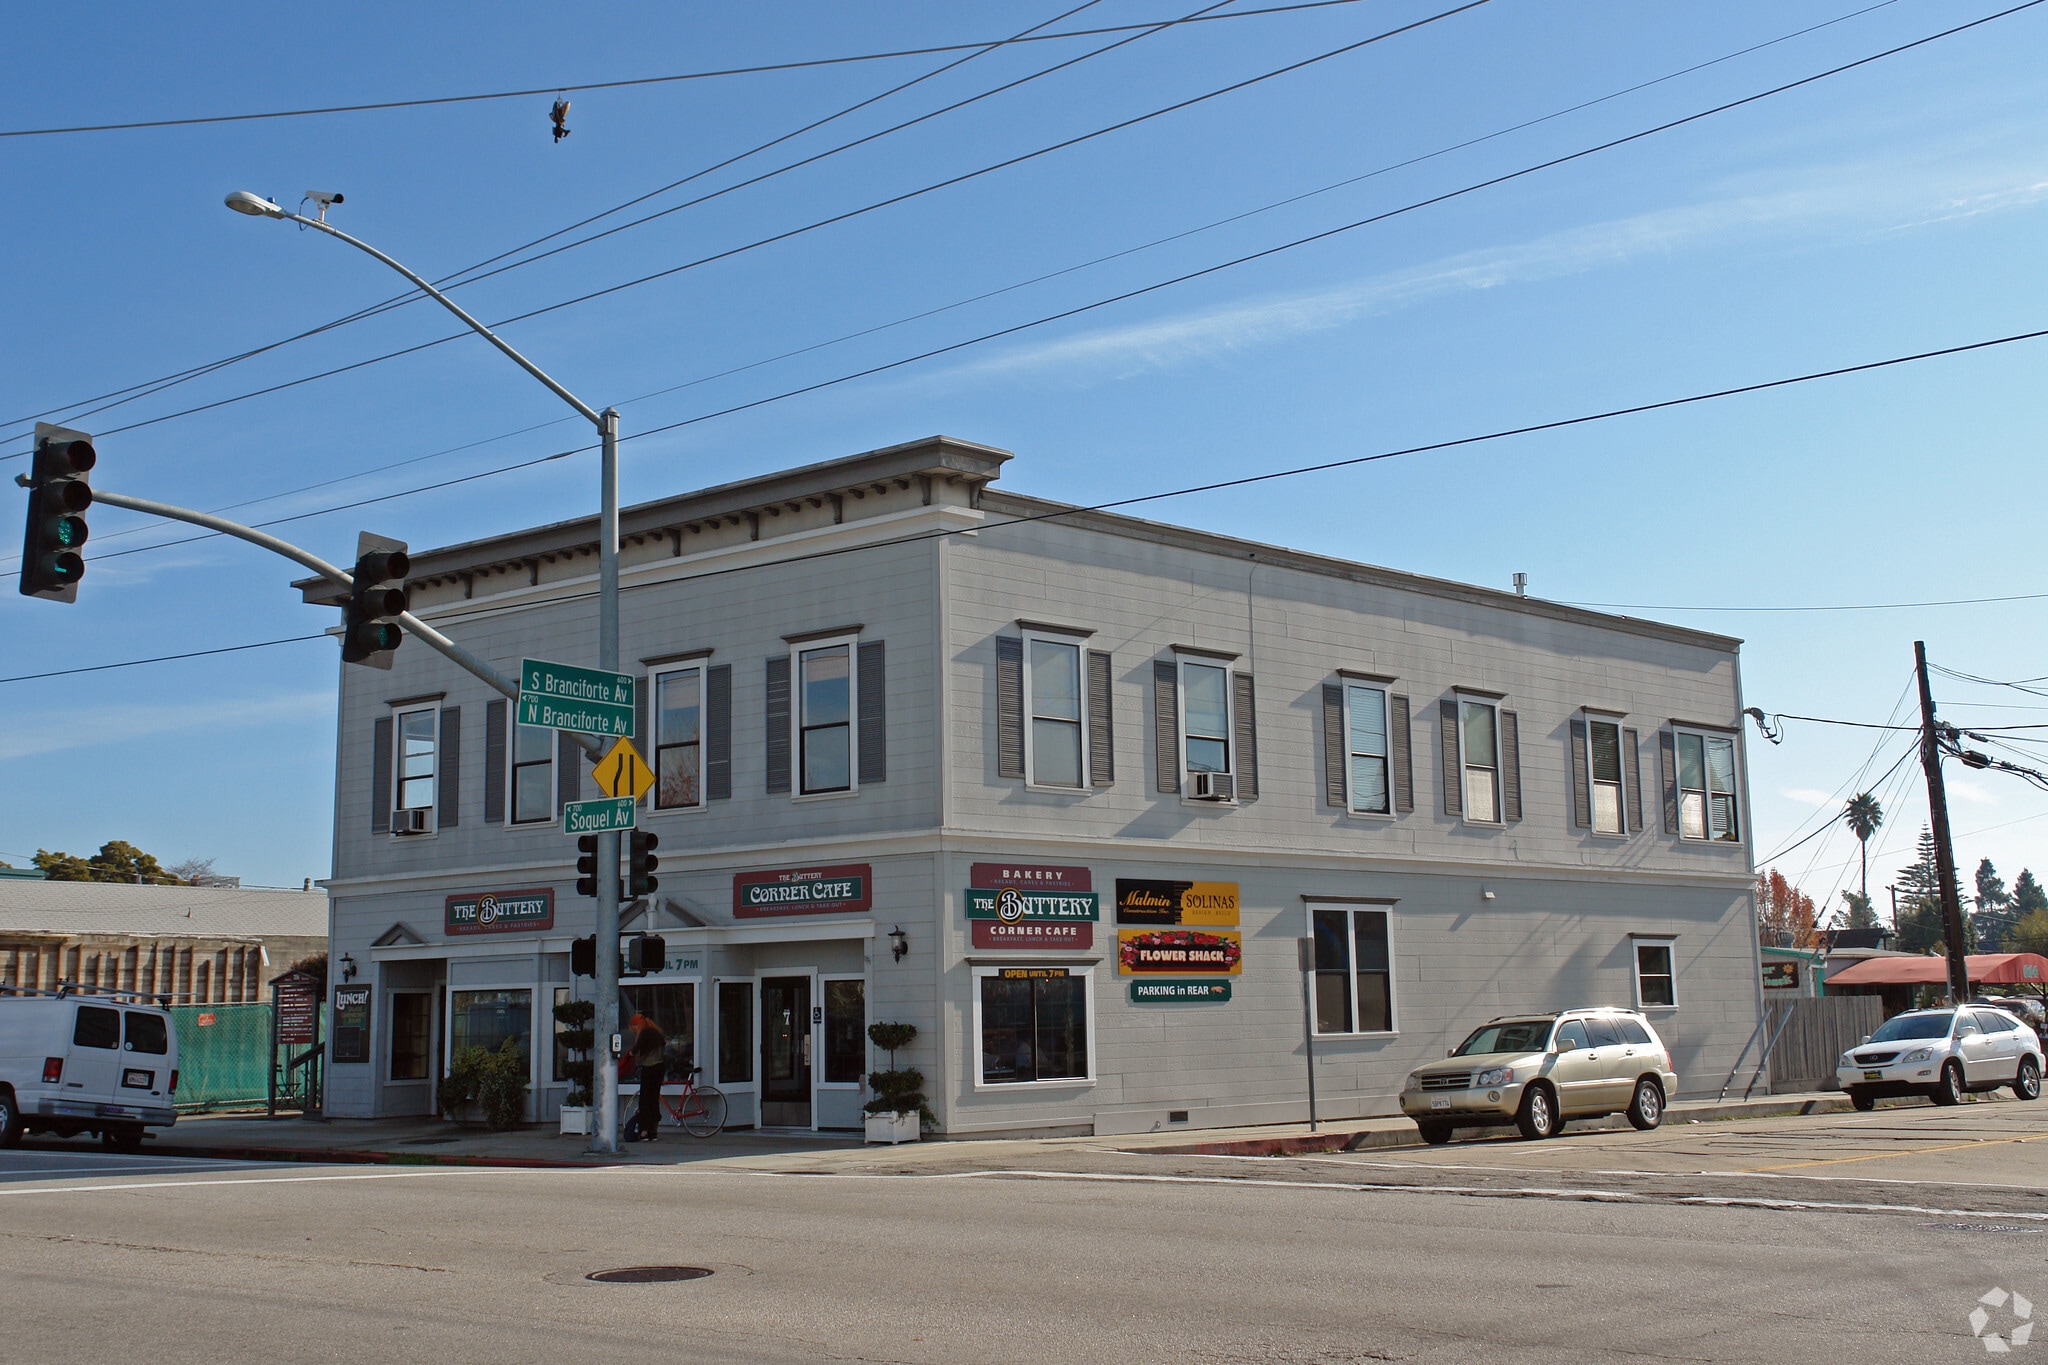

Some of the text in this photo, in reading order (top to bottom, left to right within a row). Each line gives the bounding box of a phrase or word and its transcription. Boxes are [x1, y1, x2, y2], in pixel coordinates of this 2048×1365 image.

[617, 676, 627, 684] 600
[531, 671, 627, 703] S Branciforte Av
[528, 695, 538, 704] 700
[528, 704, 627, 734] N Branciforte Av
[572, 800, 627, 812] 700 600
[570, 808, 629, 831] Soquel Av
[1002, 870, 1063, 880] BAKERY
[750, 882, 852, 903] CORNER CAFE
[1119, 890, 1171, 908] Malmin
[974, 890, 1092, 920] THE BUTTERY
[1186, 894, 1234, 909] SOLINAS
[454, 897, 544, 924] THE BUTTERY
[990, 926, 1077, 936] CORNER CAFE
[1140, 950, 1224, 962] FLOWER SHACK
[1004, 970, 1028, 978] OPEN
[1764, 974, 1794, 986] hack
[1138, 985, 1209, 996] PARKING in REAR
[336, 990, 370, 1010] LUNCH!
